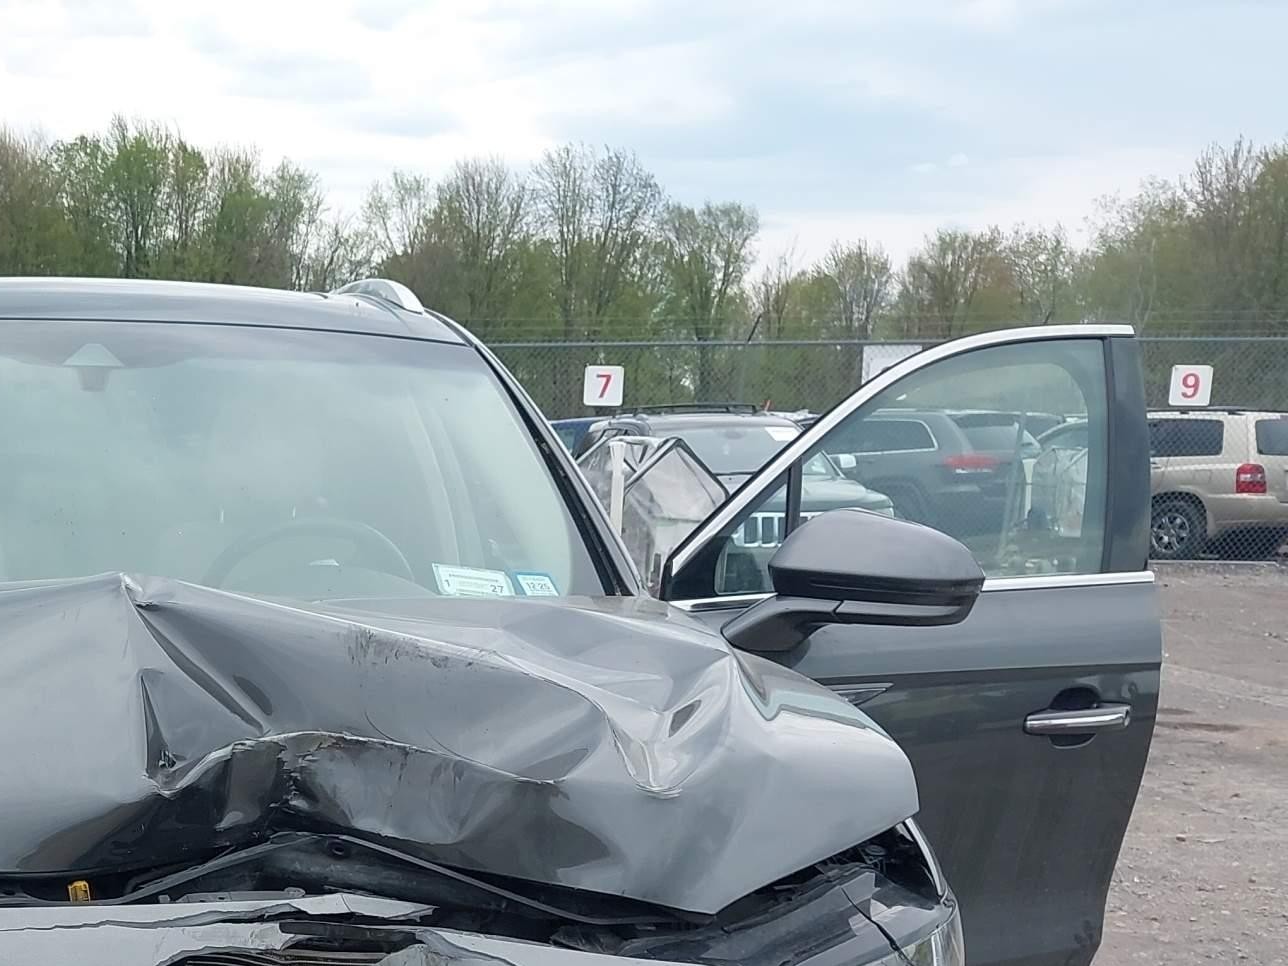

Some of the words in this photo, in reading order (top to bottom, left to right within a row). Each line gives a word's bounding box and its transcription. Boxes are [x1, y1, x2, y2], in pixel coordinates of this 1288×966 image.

[596, 374, 612, 399] 7
[1181, 372, 1201, 399] 9
[489, 584, 505, 594] 27
